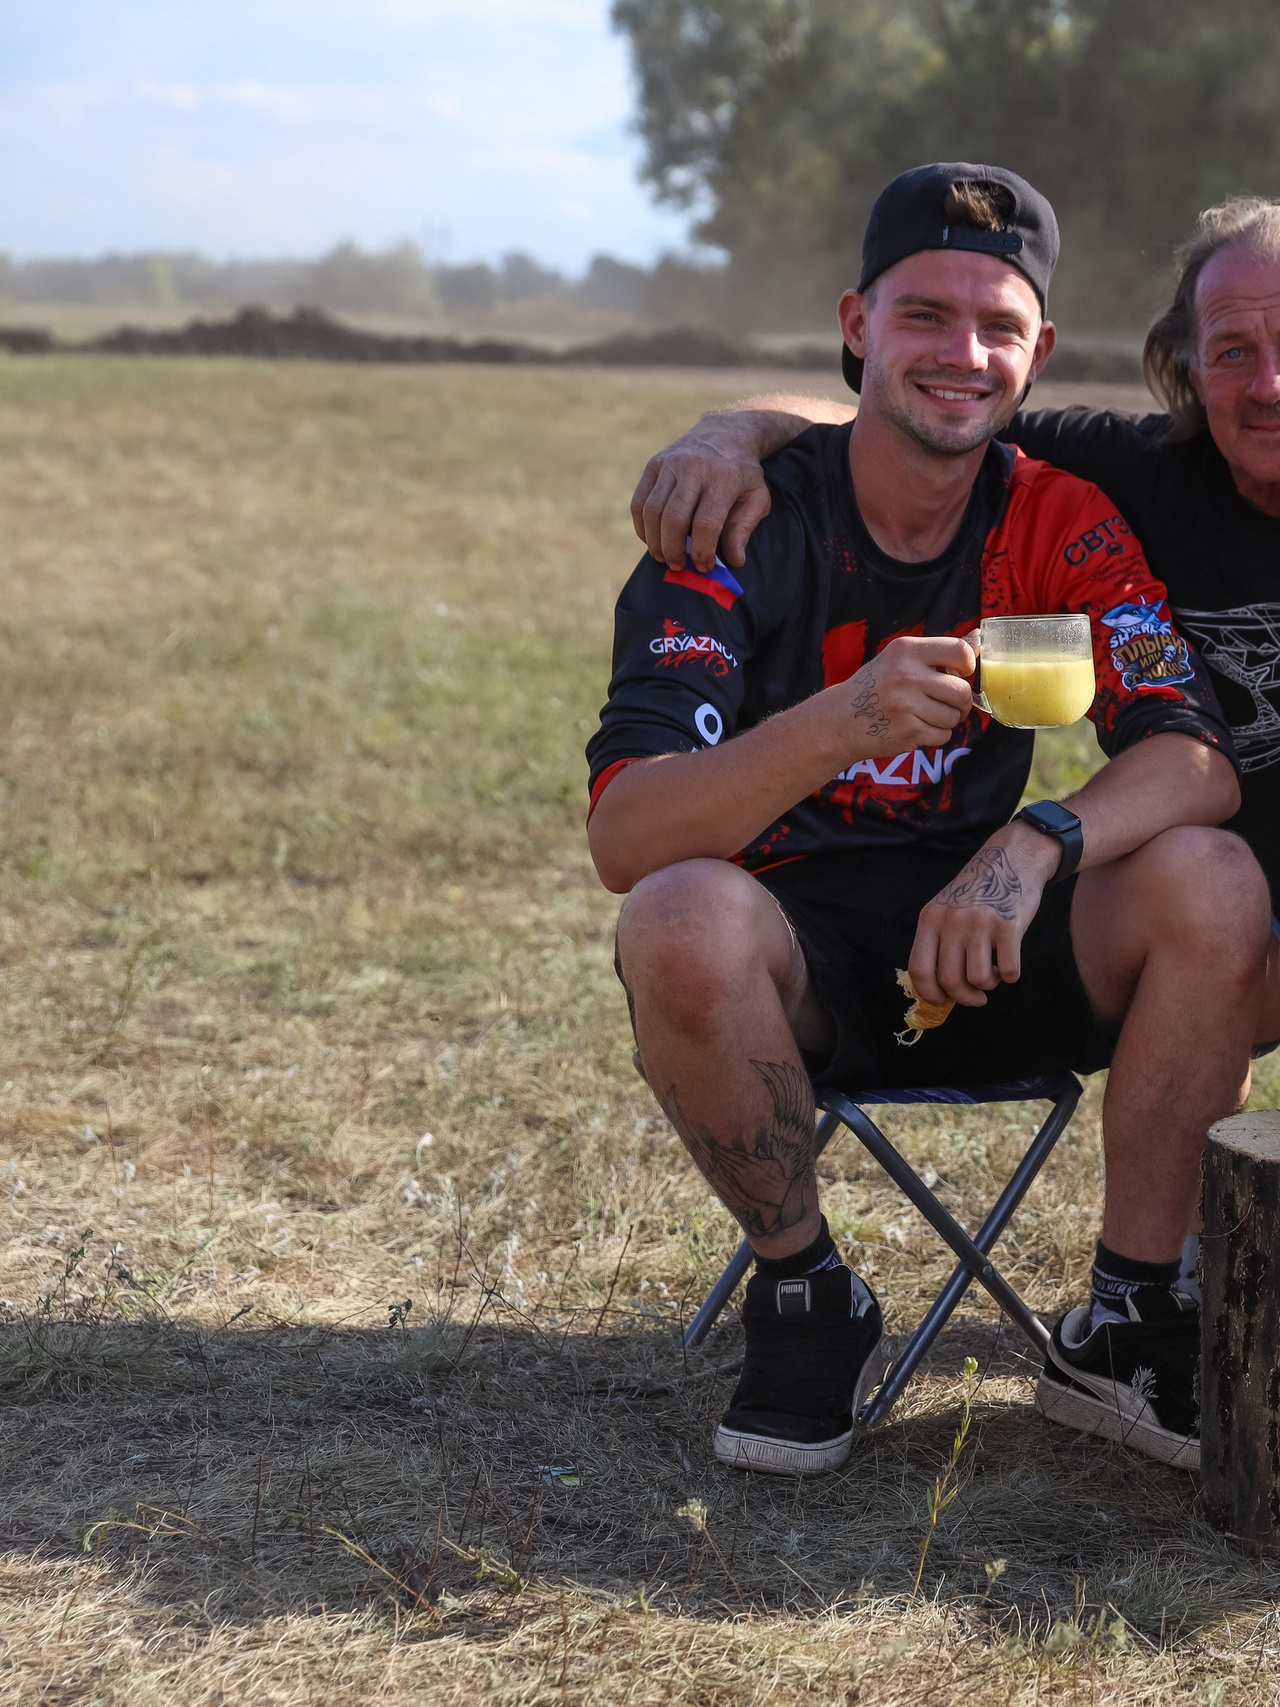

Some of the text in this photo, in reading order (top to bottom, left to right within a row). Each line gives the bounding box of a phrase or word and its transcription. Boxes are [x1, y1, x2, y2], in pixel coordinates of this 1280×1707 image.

[1109, 622, 1173, 649] SHARKS
[1115, 634, 1183, 667] ПЛЫВИ
[1140, 651, 1162, 669] ИЛИ
[781, 1283, 804, 1295] PUMA
